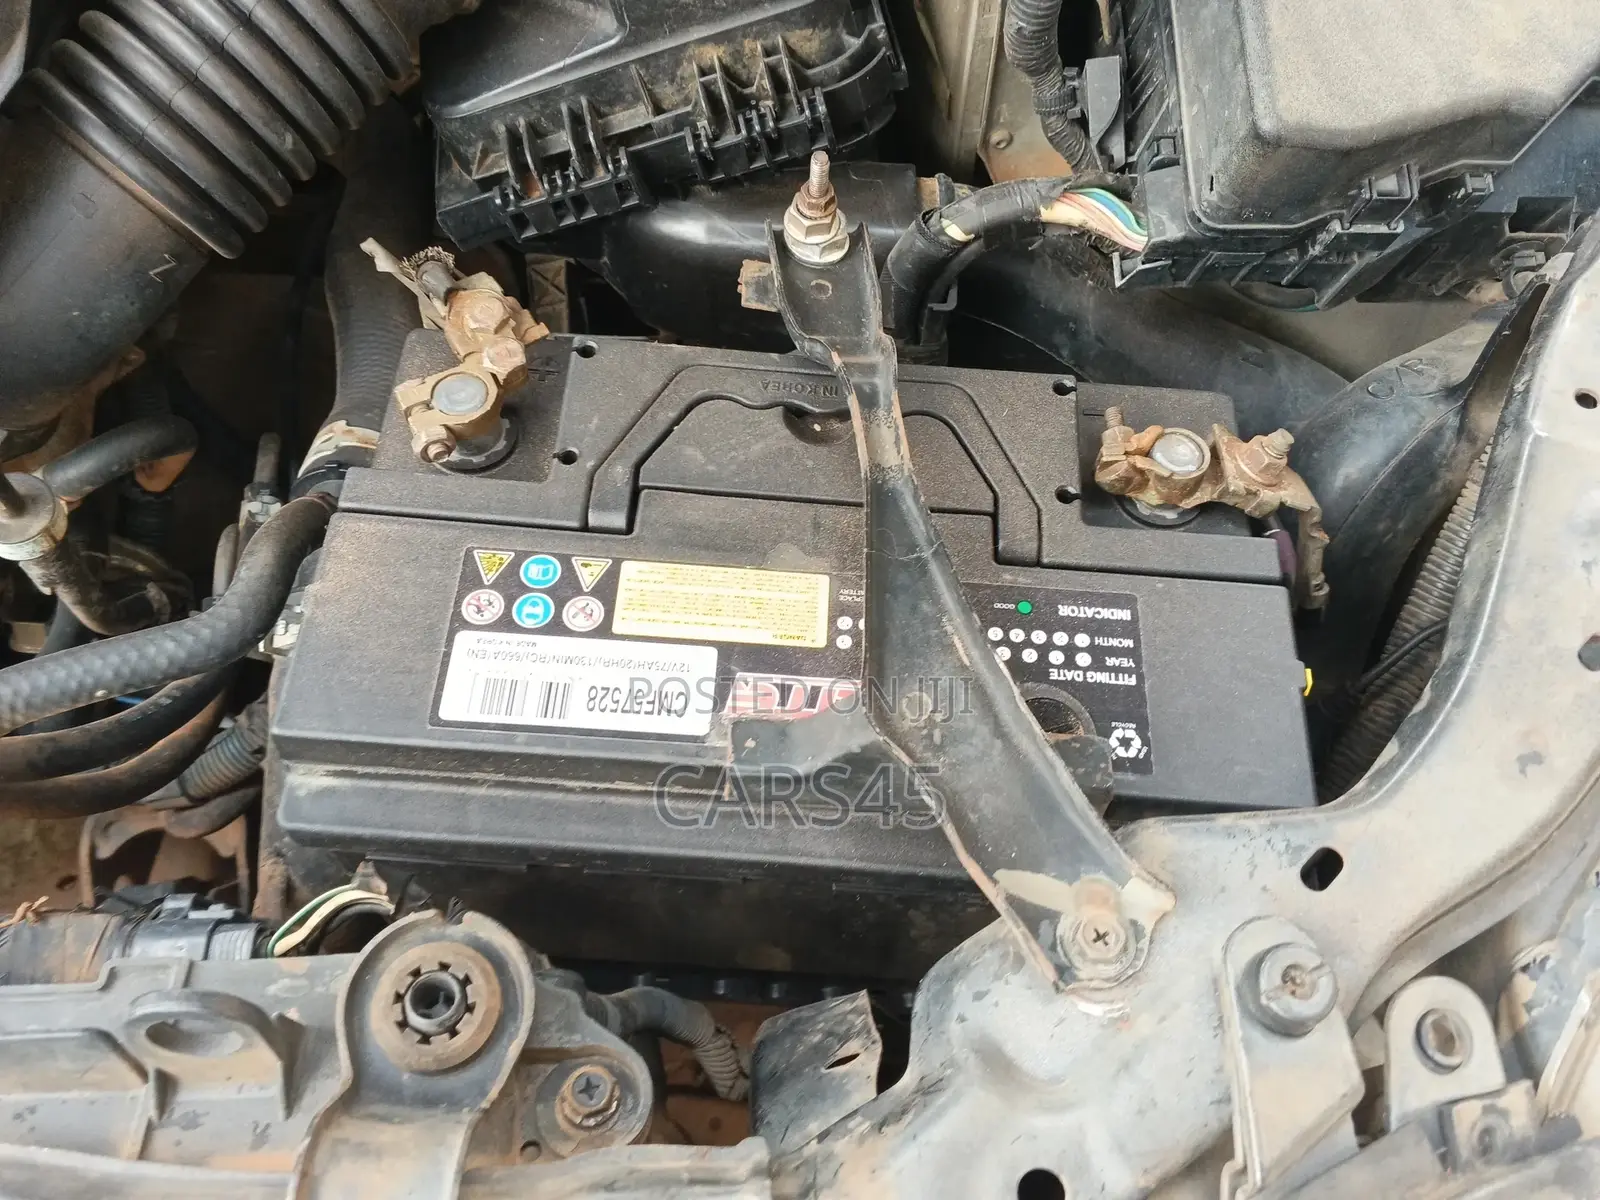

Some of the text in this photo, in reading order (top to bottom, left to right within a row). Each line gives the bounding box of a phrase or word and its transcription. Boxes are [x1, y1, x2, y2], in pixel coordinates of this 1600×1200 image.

[759, 380, 817, 396] KOREA
[1057, 604, 1132, 621] INDICATOR
[1094, 636, 1134, 649] MONTH
[1105, 656, 1136, 668] YEAR
[1048, 668, 1137, 686] FITTING DATE
[586, 685, 688, 718] CMF57528
[1111, 721, 1137, 729] RECYCLE
